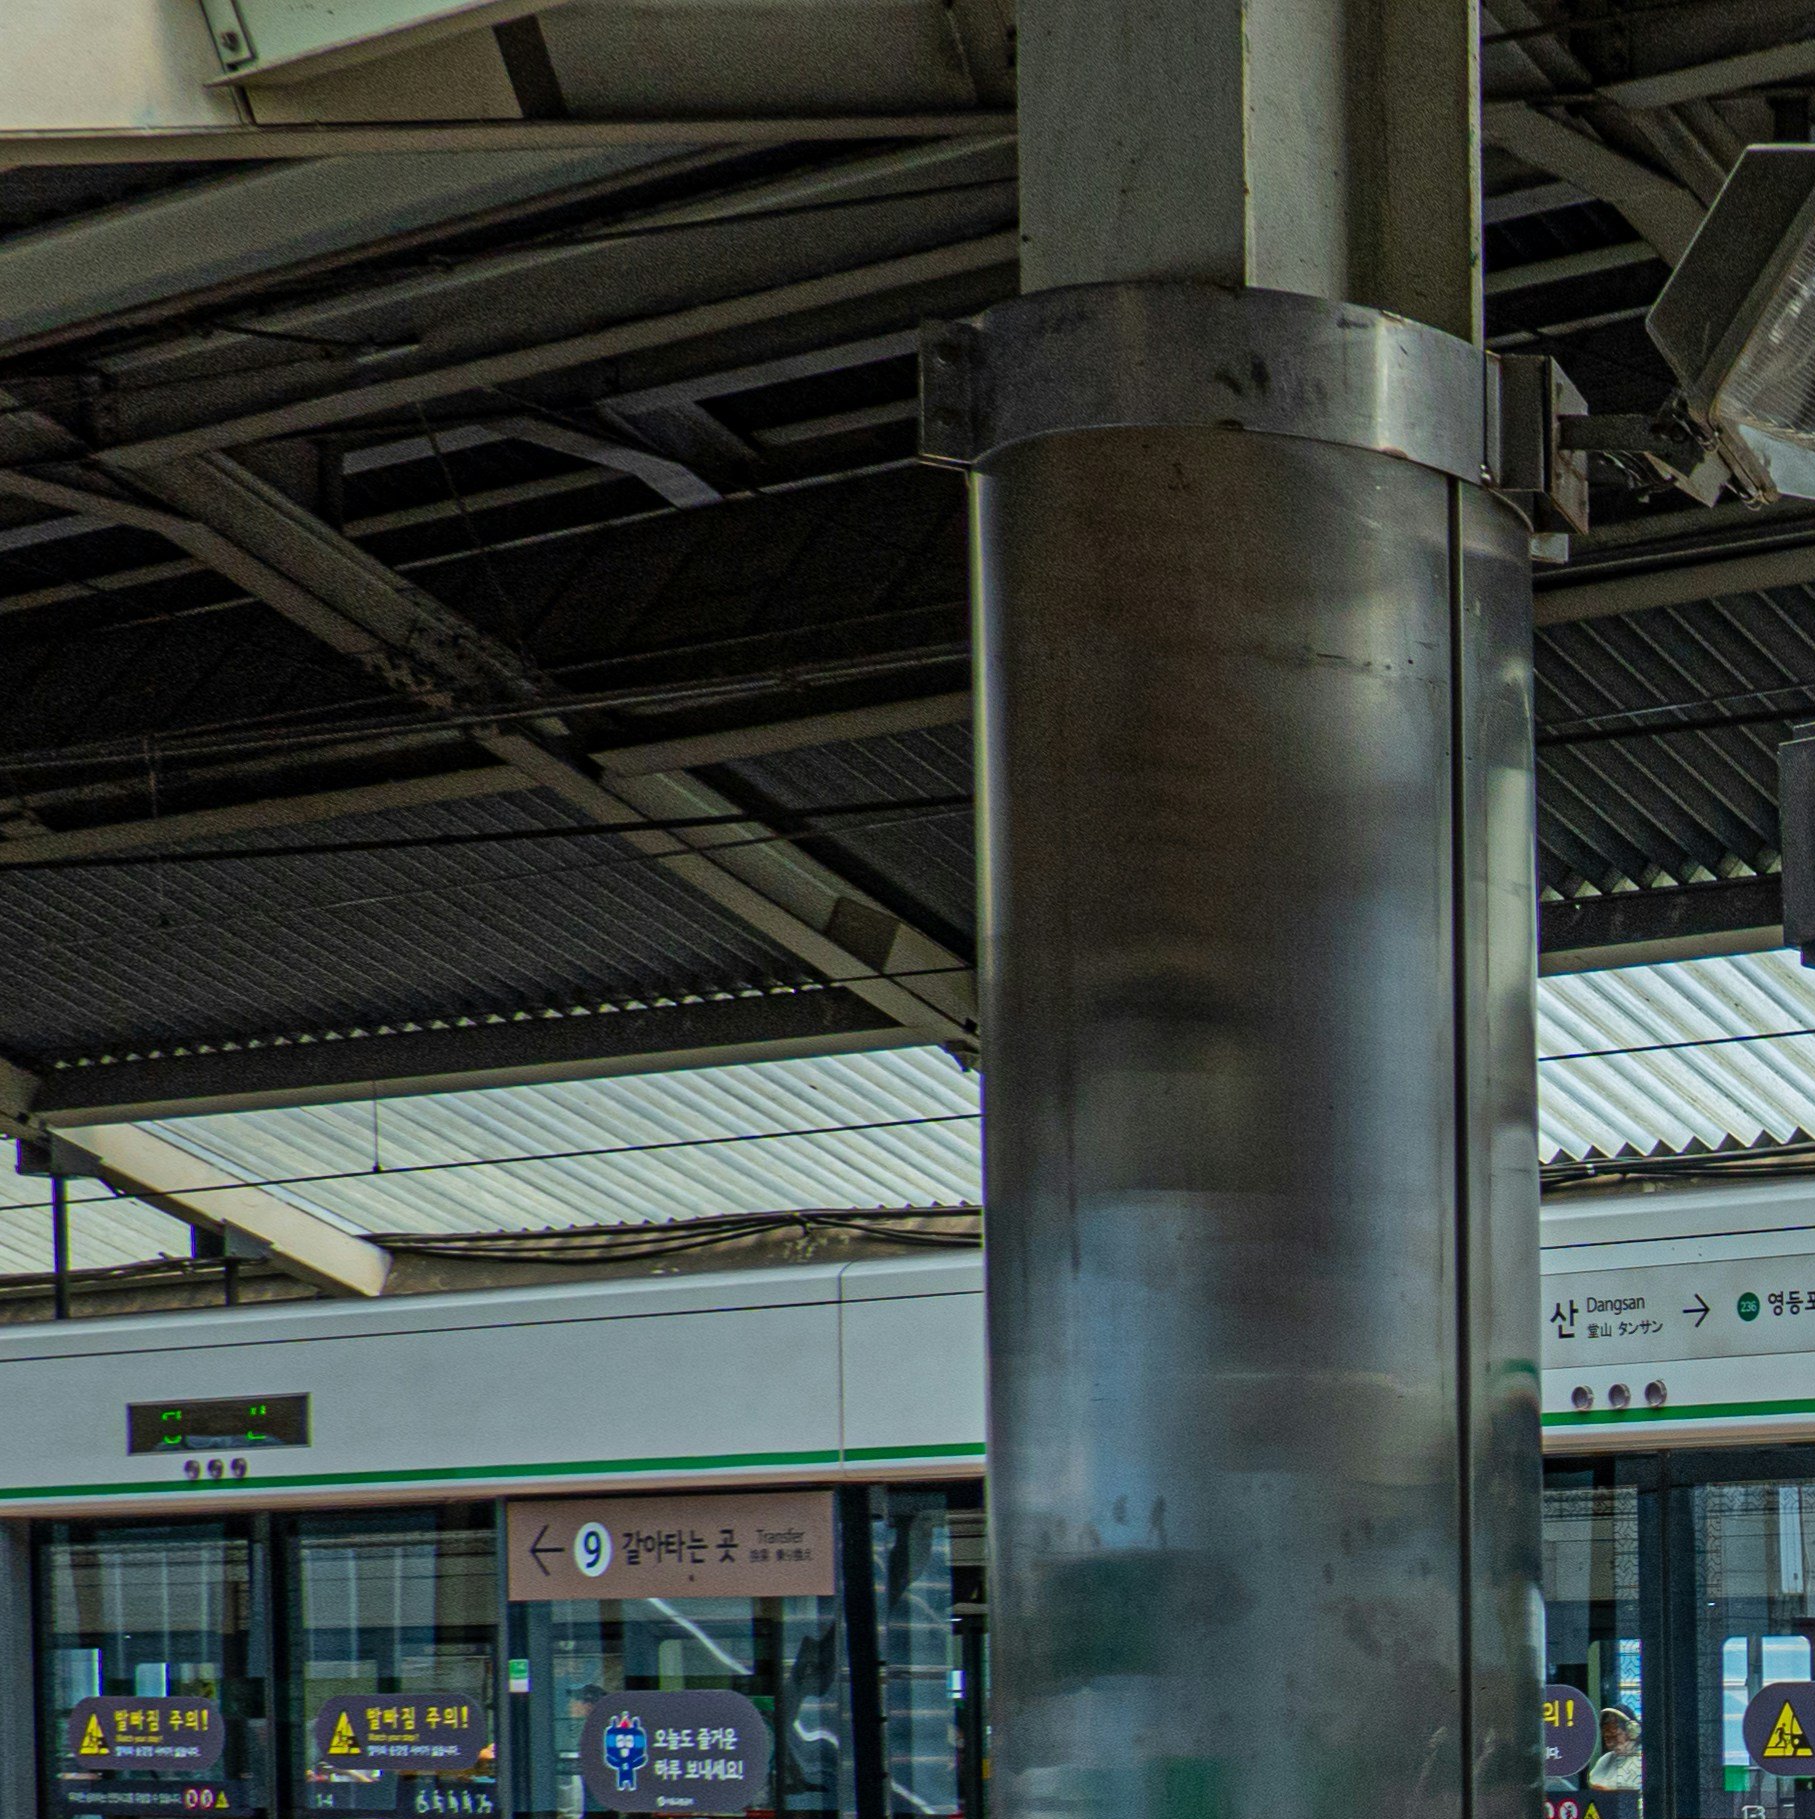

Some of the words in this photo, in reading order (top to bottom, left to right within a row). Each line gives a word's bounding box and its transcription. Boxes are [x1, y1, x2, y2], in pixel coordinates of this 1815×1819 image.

[1586, 1296, 1646, 1316] Dangsan
[1740, 1302, 1757, 1313] 236
[1549, 1299, 1579, 1339] 산
[1587, 1322, 1613, 1339] 堂山
[1618, 1320, 1664, 1337] タンサン
[755, 1527, 805, 1544] Transfer
[583, 1530, 601, 1569] 9
[621, 1529, 709, 1566] 갈아타는
[715, 1528, 739, 1563] 곳
[113, 1709, 160, 1732] 발빠짐
[169, 1708, 209, 1731] 주의!
[366, 1706, 415, 1730] 발빠짐
[425, 1705, 469, 1729] 주의!
[652, 1728, 695, 1750] 오늘도
[697, 1727, 738, 1750] 즐거운
[654, 1758, 683, 1781] 하루
[684, 1758, 744, 1781] 보내세요!
